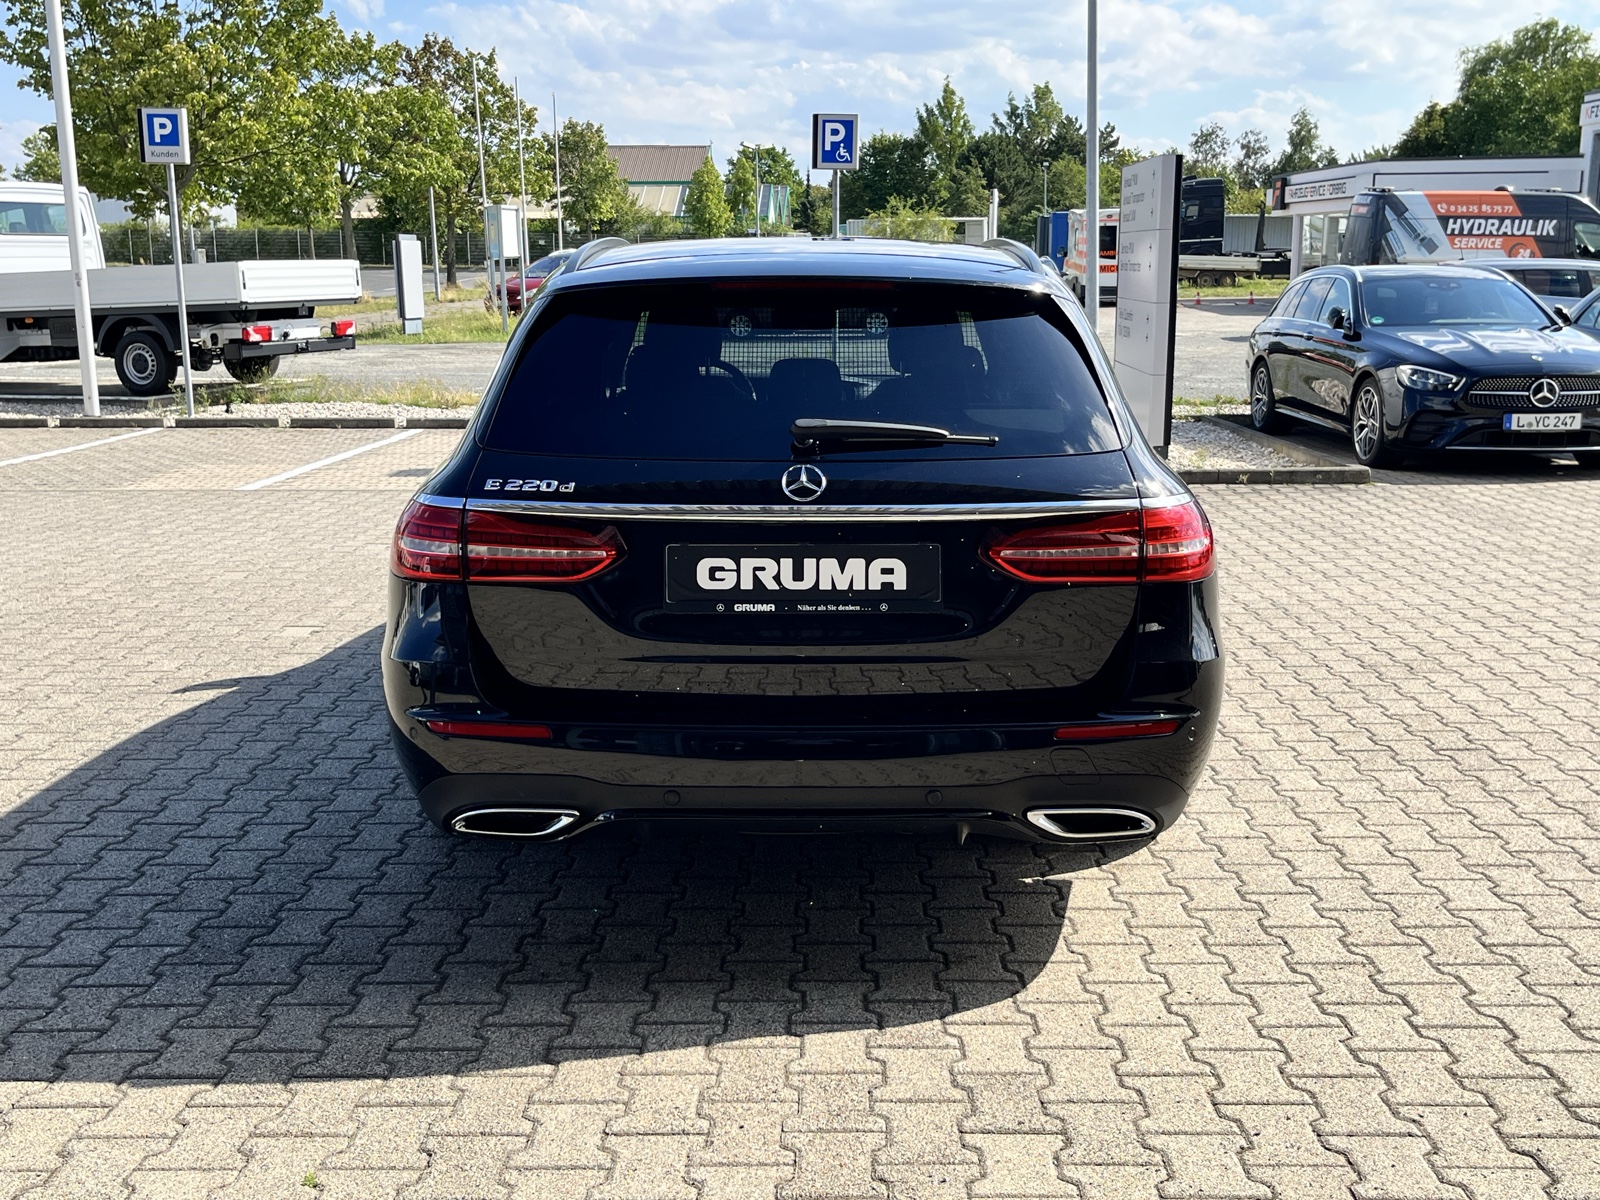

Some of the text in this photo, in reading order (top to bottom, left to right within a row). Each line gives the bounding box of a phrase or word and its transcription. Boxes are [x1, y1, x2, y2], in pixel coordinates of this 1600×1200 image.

[153, 117, 173, 142] P
[824, 122, 846, 151] P
[151, 150, 179, 158] Kunden
[1450, 204, 1513, 214] 0 34 25 85 75 77
[1446, 219, 1557, 236] HYDRAULIK
[1453, 237, 1503, 249] SERVICE
[1516, 416, 1576, 428] L YC 247
[484, 479, 503, 490] E
[504, 479, 558, 492] 220
[696, 557, 907, 591] GRUMA
[734, 603, 775, 612] GRUMA
[797, 604, 816, 612] Näher
